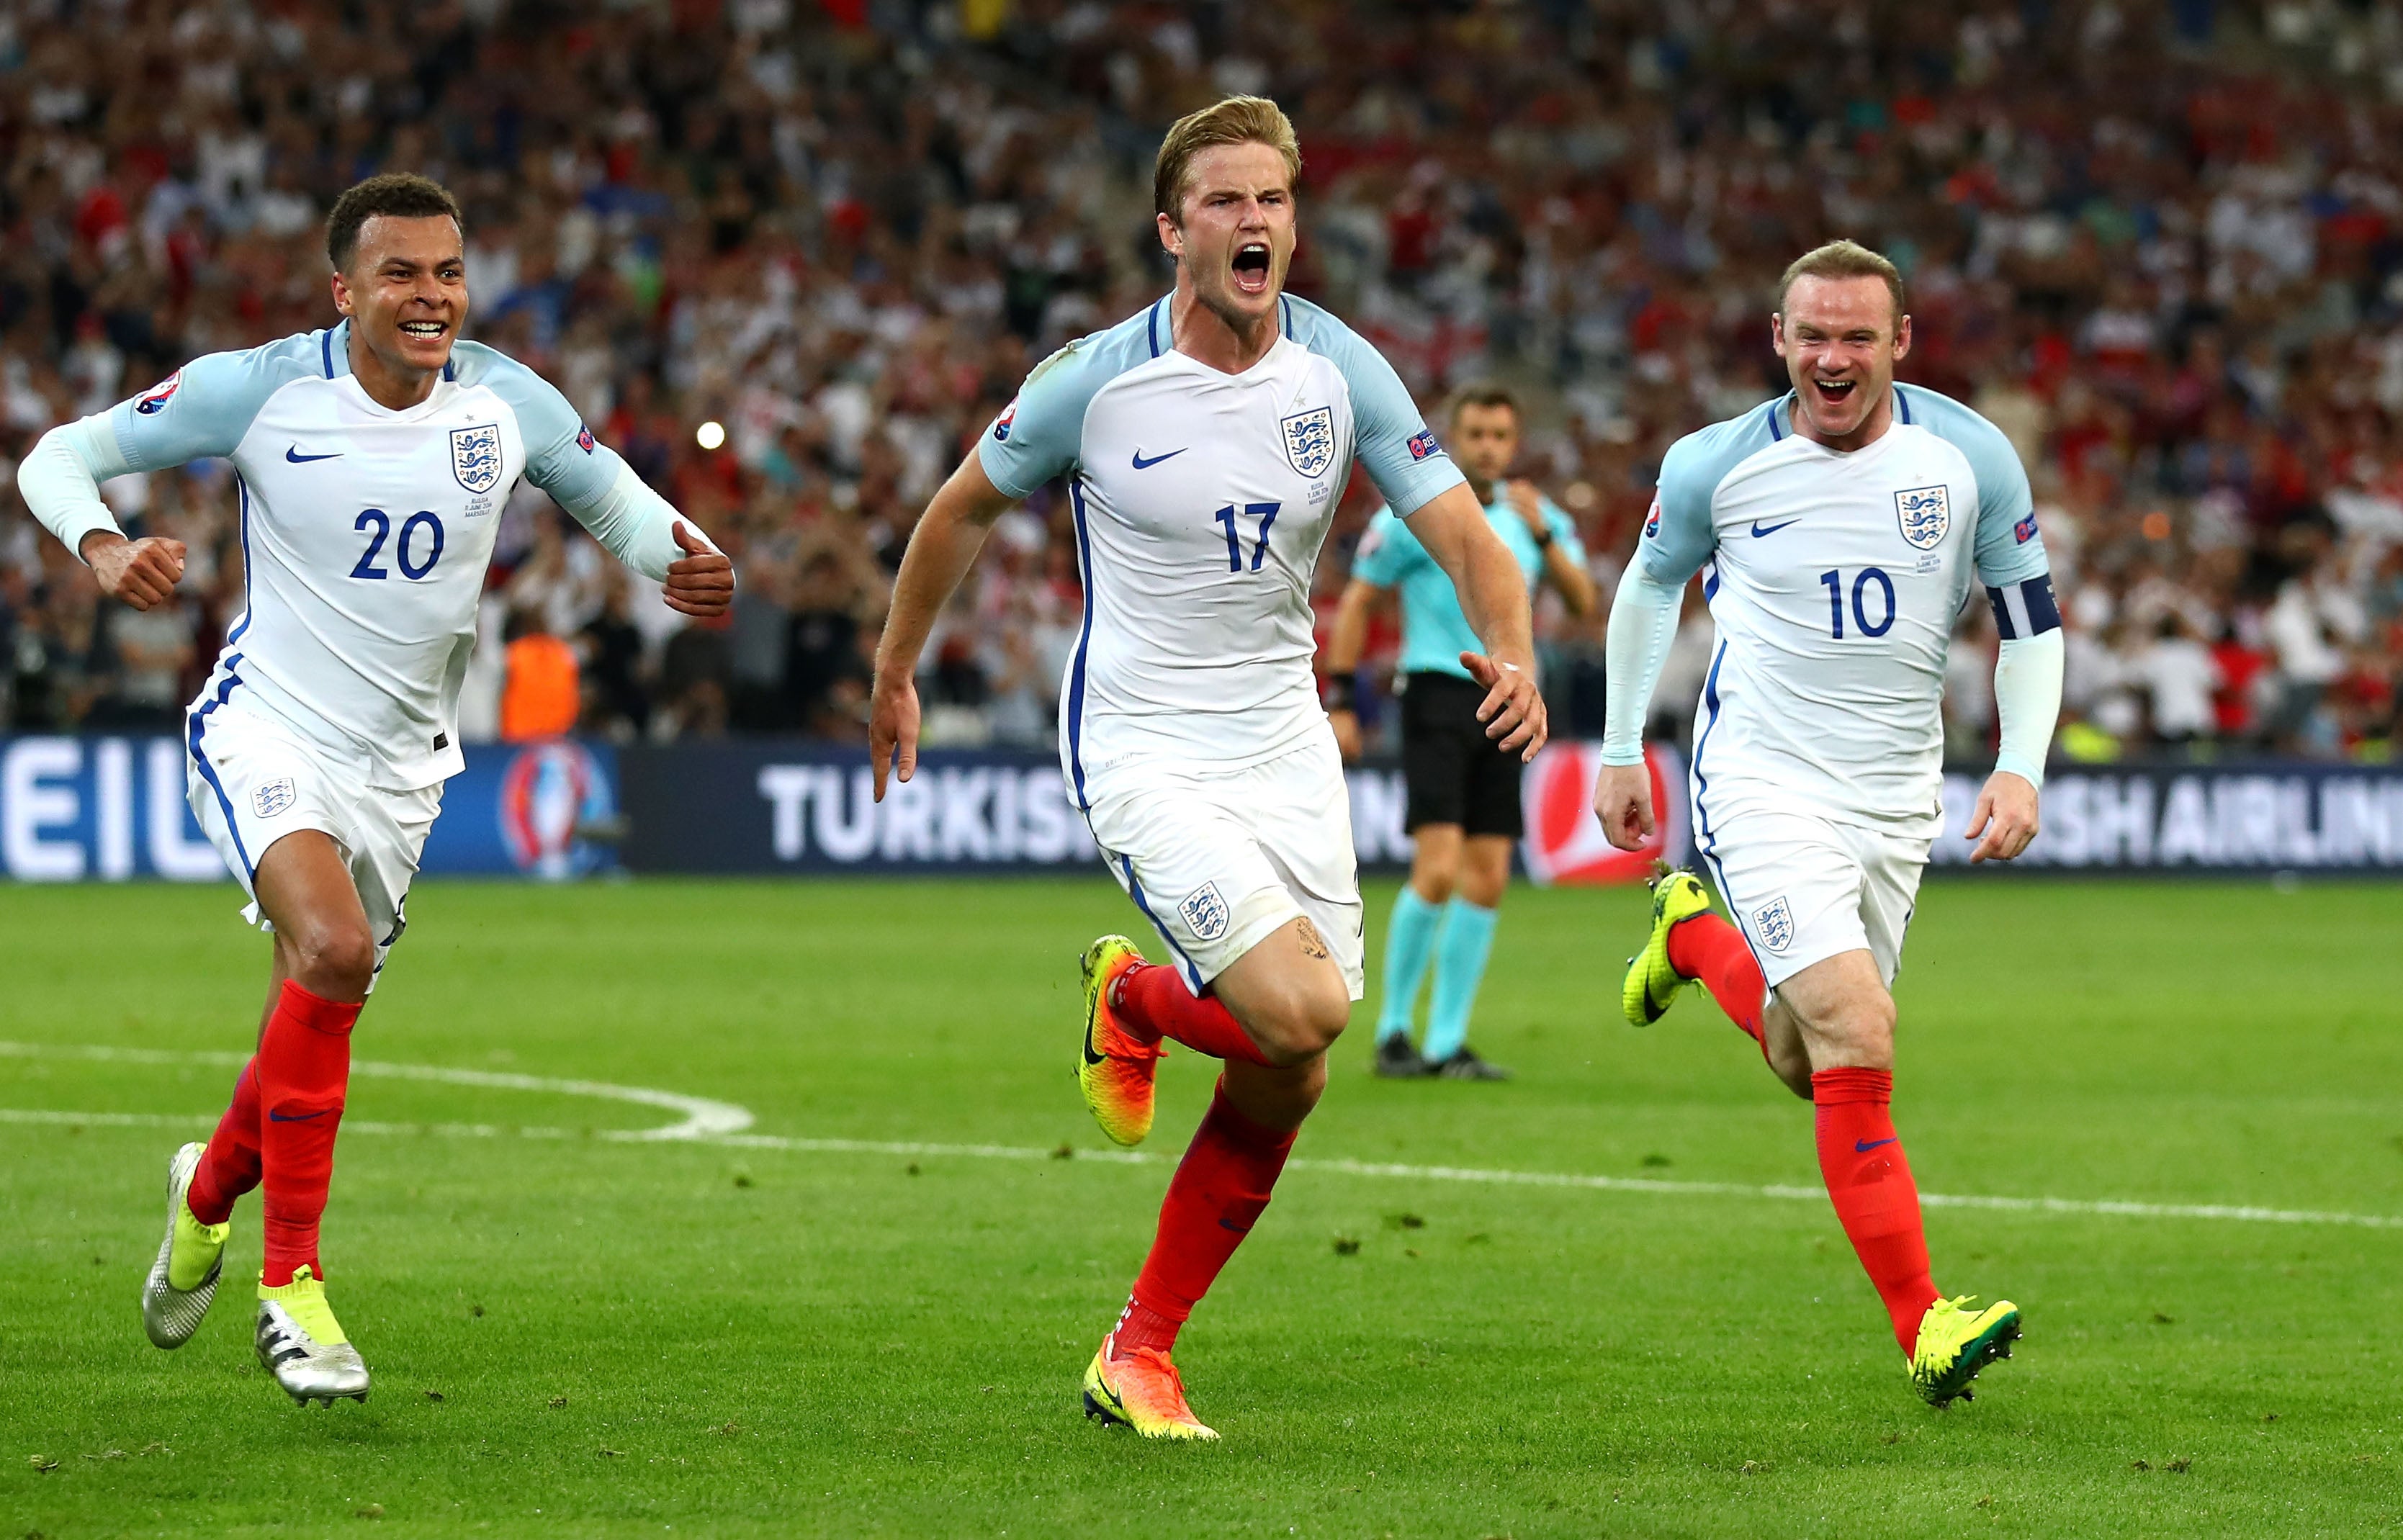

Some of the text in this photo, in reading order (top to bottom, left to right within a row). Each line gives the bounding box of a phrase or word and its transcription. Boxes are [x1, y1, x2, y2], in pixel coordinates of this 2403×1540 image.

[349, 508, 444, 580] 20
[1216, 503, 1281, 572] 17
[1820, 567, 1895, 639] 10
